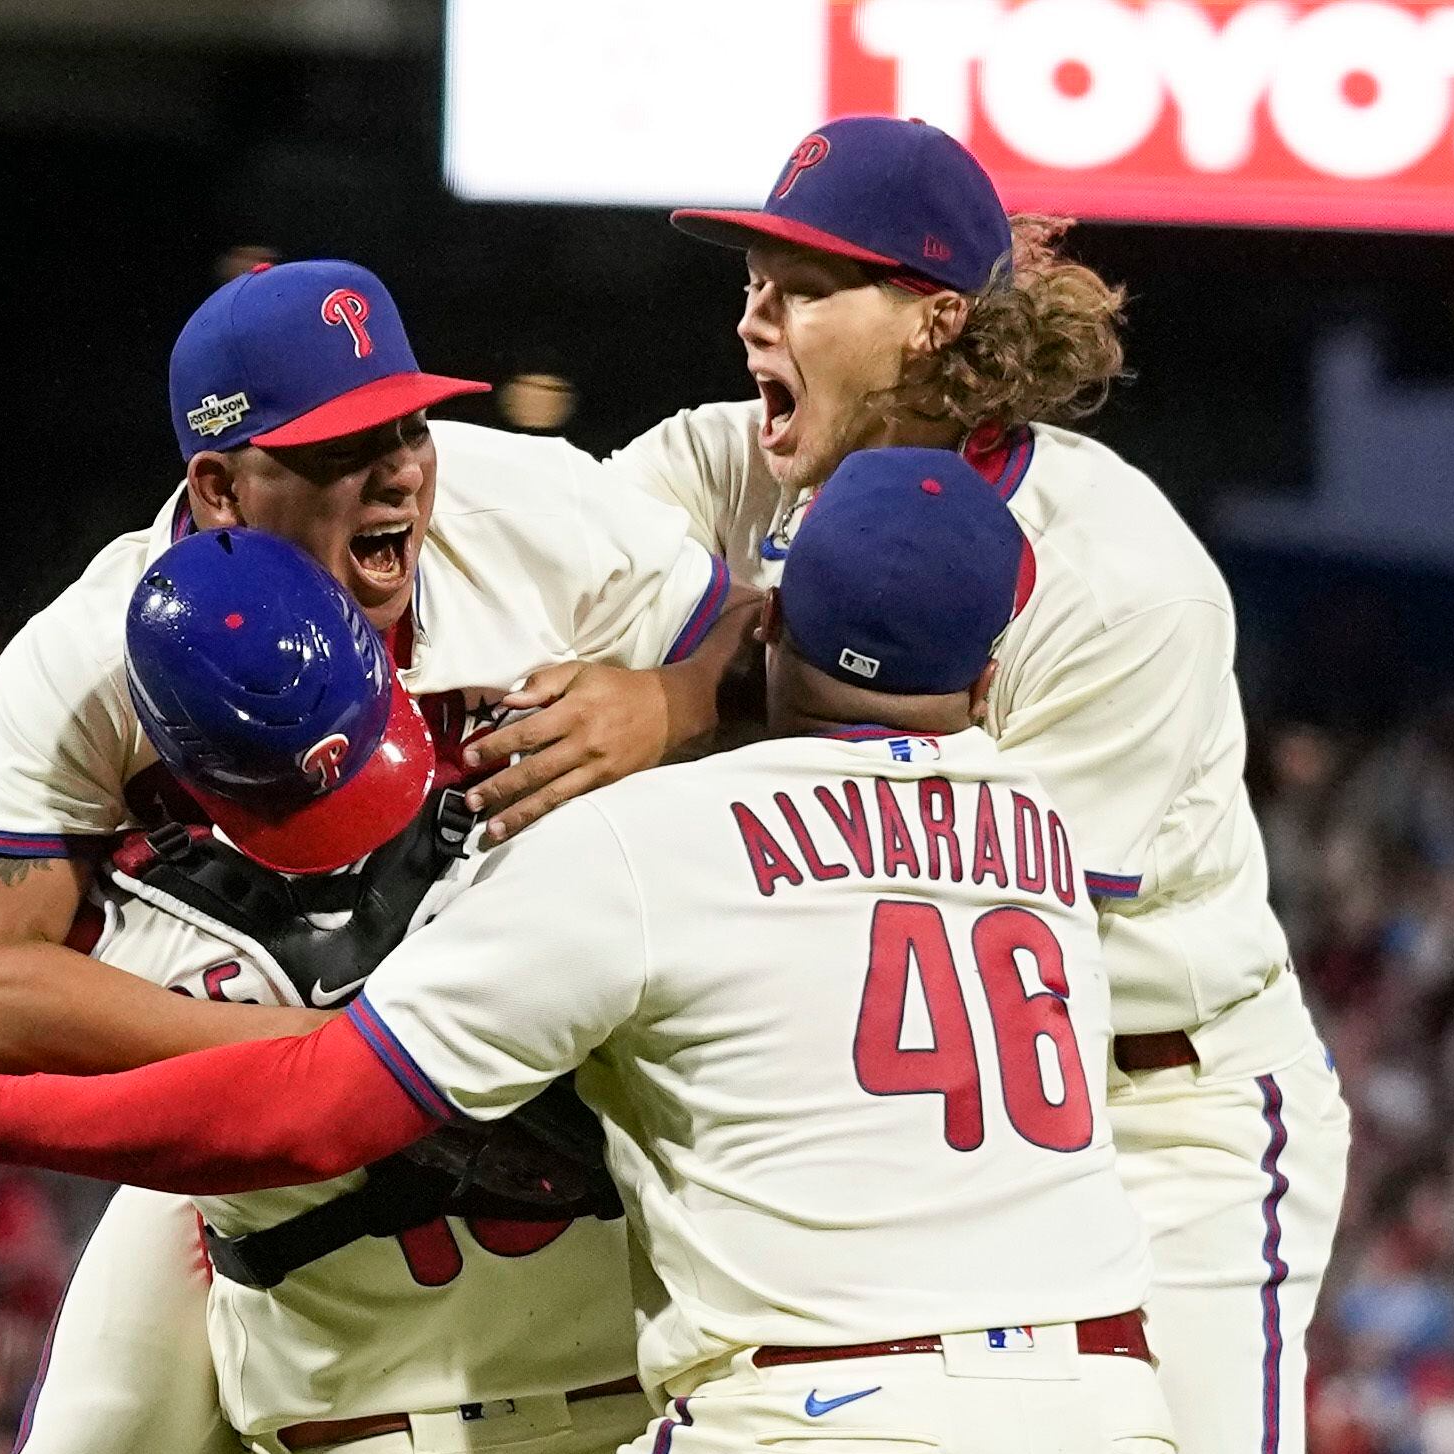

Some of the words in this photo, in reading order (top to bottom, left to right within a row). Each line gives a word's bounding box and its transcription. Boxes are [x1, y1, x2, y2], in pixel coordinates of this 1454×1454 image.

[777, 133, 830, 199] P
[321, 288, 373, 358] P
[190, 397, 245, 425] POSTSEASON
[730, 776, 1076, 907] ALVARADO
[853, 900, 1093, 1152] 46
